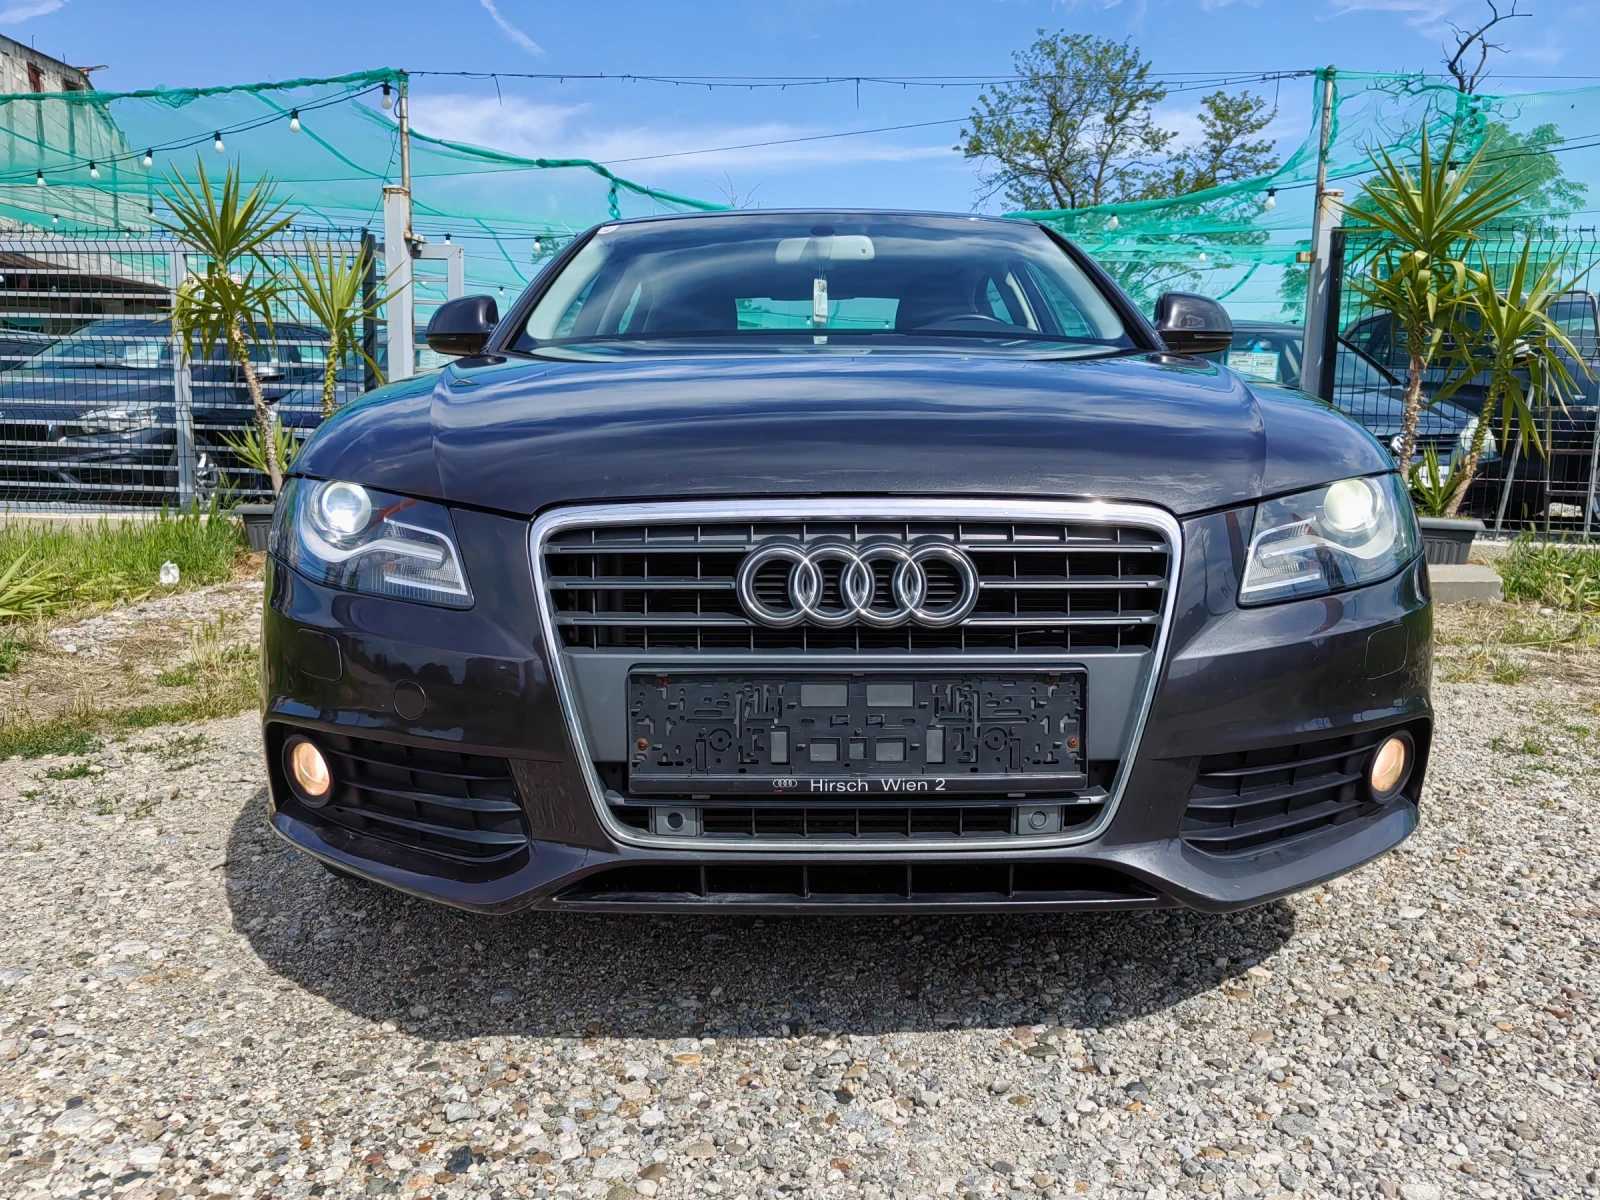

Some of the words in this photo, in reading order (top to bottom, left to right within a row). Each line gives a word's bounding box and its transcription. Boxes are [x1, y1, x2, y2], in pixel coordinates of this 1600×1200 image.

[810, 779, 869, 792] Hirsch
[881, 778, 928, 791] Wien
[935, 778, 946, 791] 2
